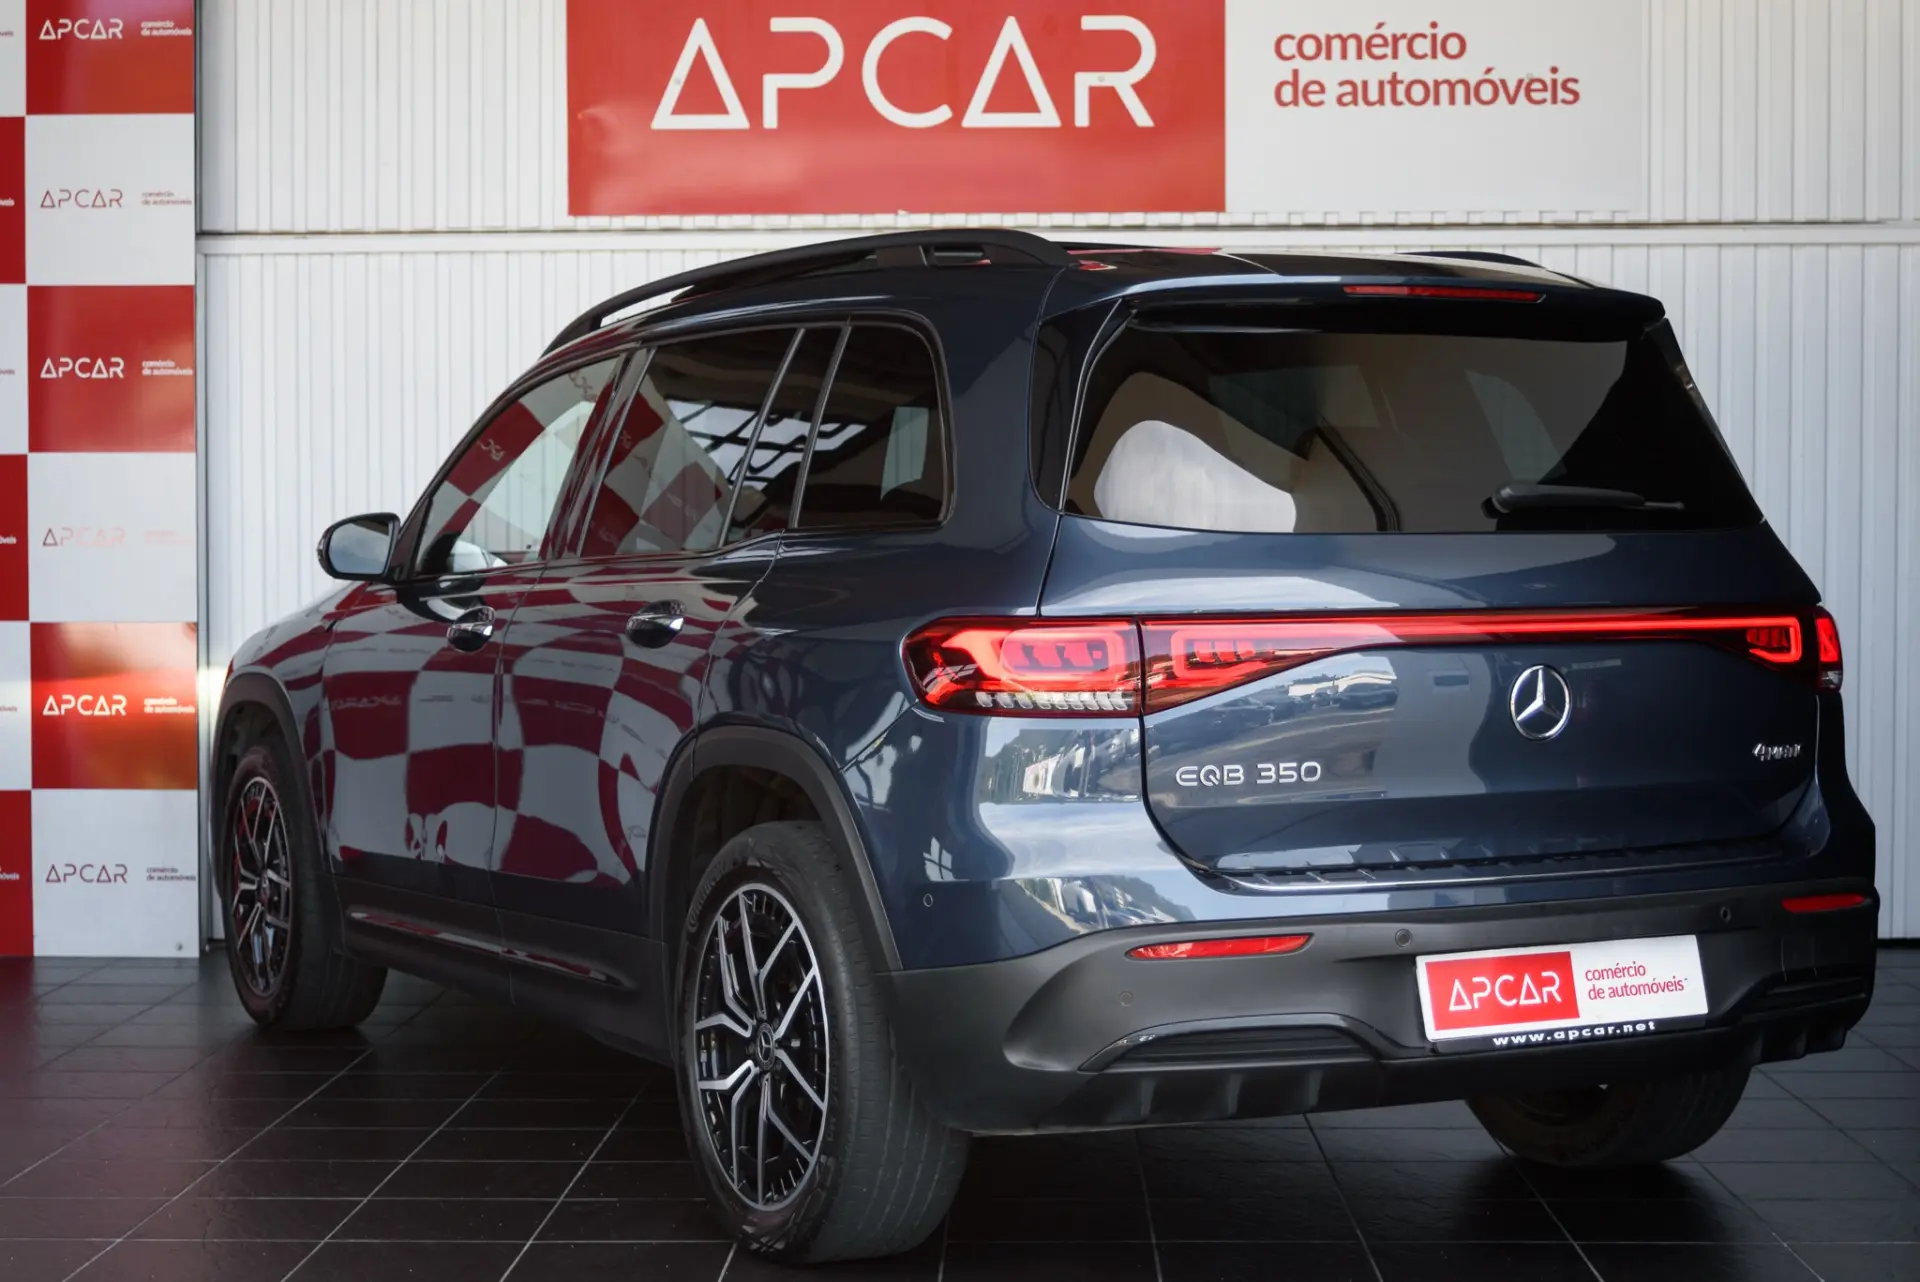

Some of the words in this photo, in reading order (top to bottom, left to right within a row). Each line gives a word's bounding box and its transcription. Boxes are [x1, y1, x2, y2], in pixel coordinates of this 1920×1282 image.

[38, 18, 124, 40] APCAR
[1273, 21, 1467, 62] comércio
[650, 14, 1157, 130] APCAR
[1274, 68, 1326, 107] de
[1335, 66, 1581, 107] automóveis
[40, 189, 123, 208] APCAR
[40, 357, 125, 379] APCAR
[43, 694, 127, 716] APCAR
[1175, 764, 1245, 787] EQB
[1256, 761, 1321, 784] 350
[45, 864, 128, 884] APCAR
[1584, 961, 1647, 982] comércio
[1448, 971, 1562, 1012] APCAR
[1587, 984, 1606, 1001] de
[1608, 976, 1684, 999] automóveis
[1492, 1020, 1656, 1047] www.apcar.net
